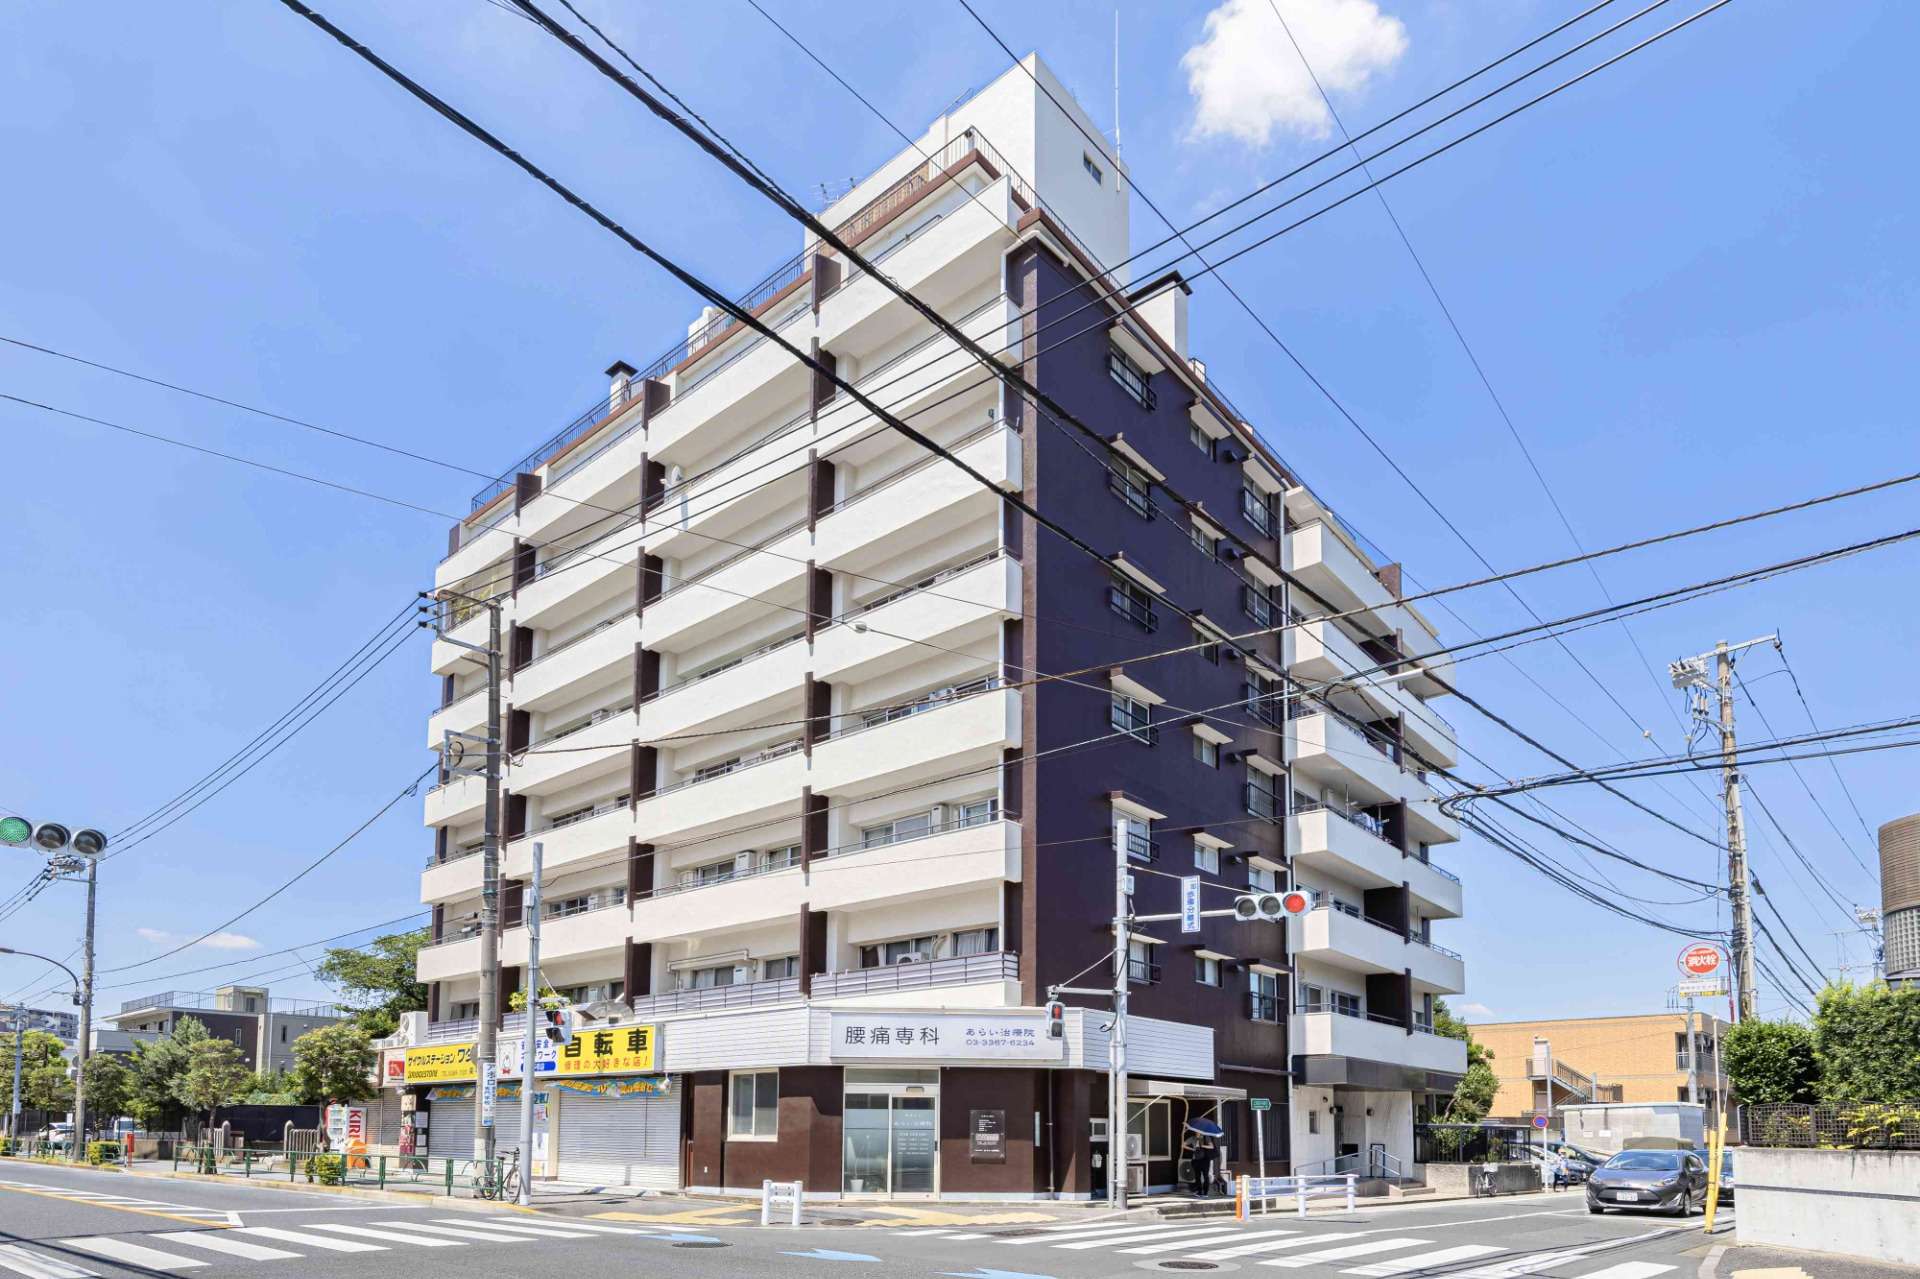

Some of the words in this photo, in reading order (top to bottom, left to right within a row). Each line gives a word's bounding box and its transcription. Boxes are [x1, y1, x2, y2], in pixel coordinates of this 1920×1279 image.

[564, 1028, 648, 1058] 自転車
[845, 1026, 940, 1046] 腰痛専科
[965, 1028, 1035, 1038] あらい治療院
